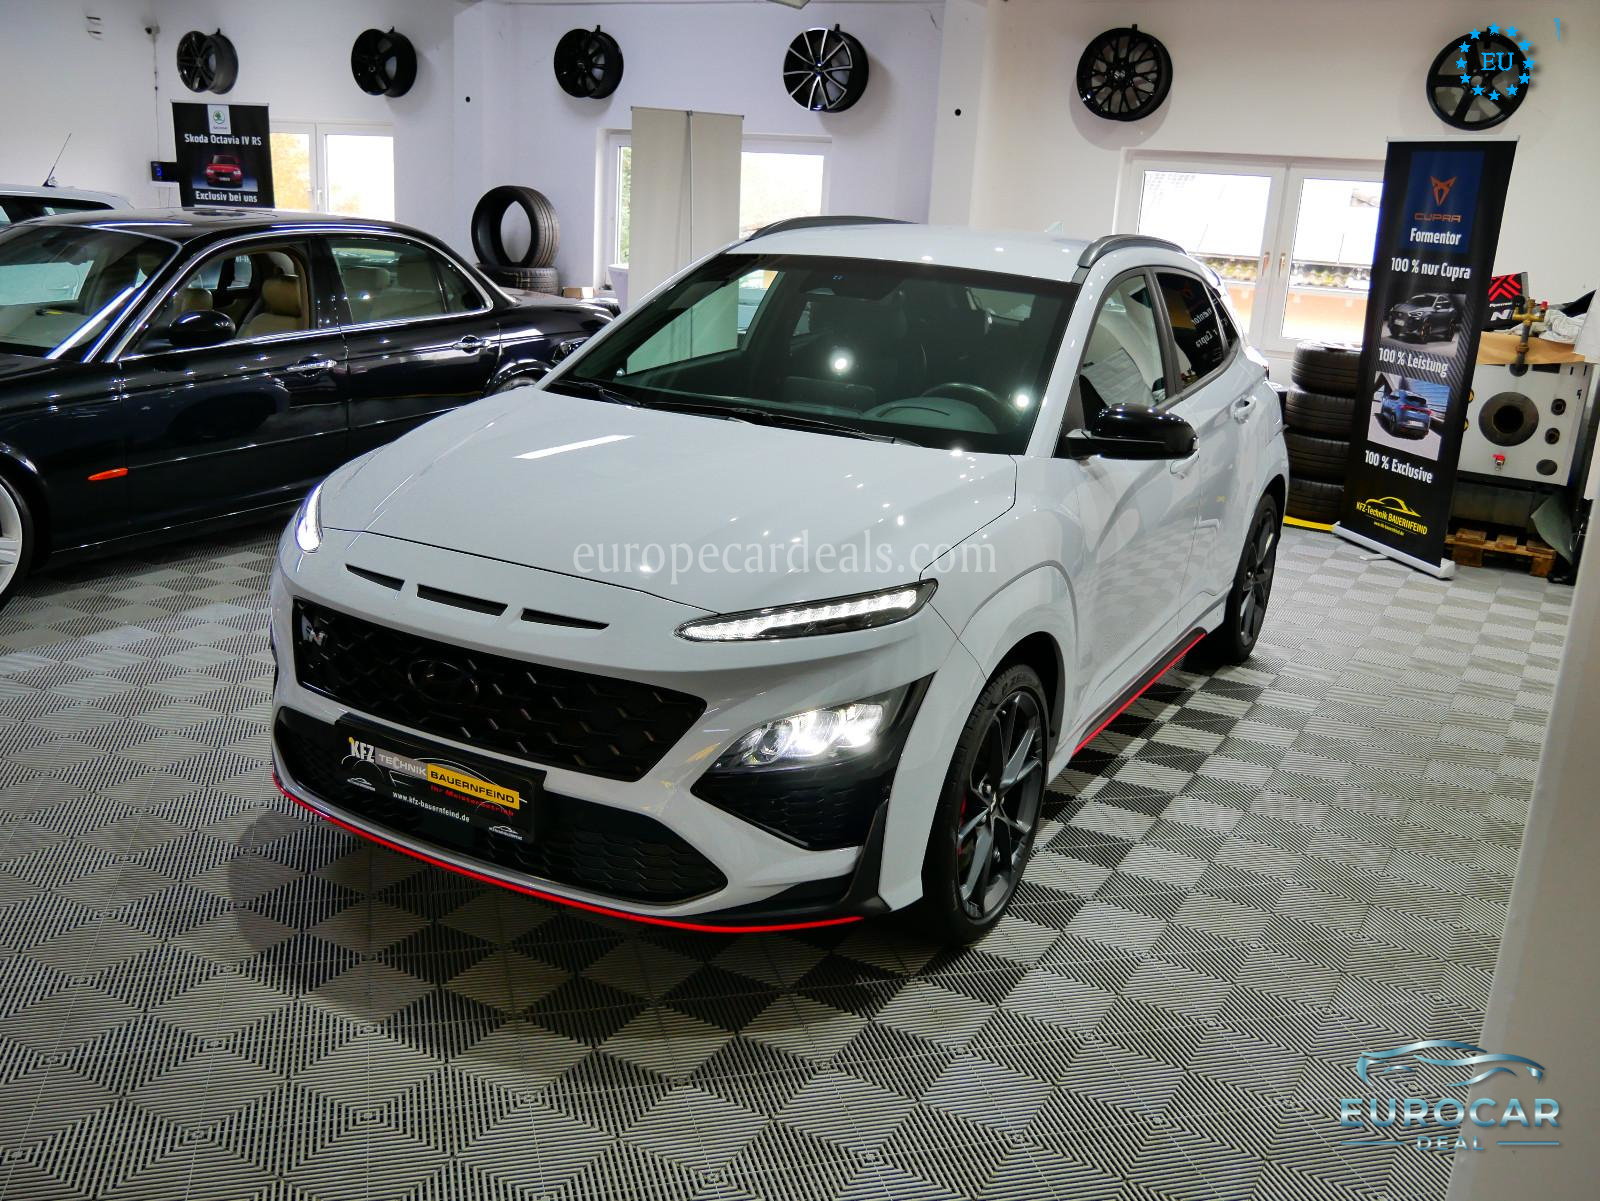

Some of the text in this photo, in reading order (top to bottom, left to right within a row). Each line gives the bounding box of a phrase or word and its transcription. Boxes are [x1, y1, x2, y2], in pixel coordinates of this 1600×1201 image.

[184, 133, 262, 146] Skoda Octavia IV RS
[195, 190, 258, 203] Exclusiv bei uns
[1414, 212, 1463, 223] CUPRA
[1409, 227, 1463, 246] Formentor
[1391, 257, 1471, 282] 100 % nur Cupra
[1378, 347, 1449, 378] 100 % Leistung
[1365, 450, 1433, 484] 100 % Exclusive
[1387, 513, 1428, 535] BAUERNFEIND
[350, 740, 515, 804] KFZ TECHNIK BAUERNFEIND
[392, 791, 470, 823] www.kfz-bauernfeind.de
